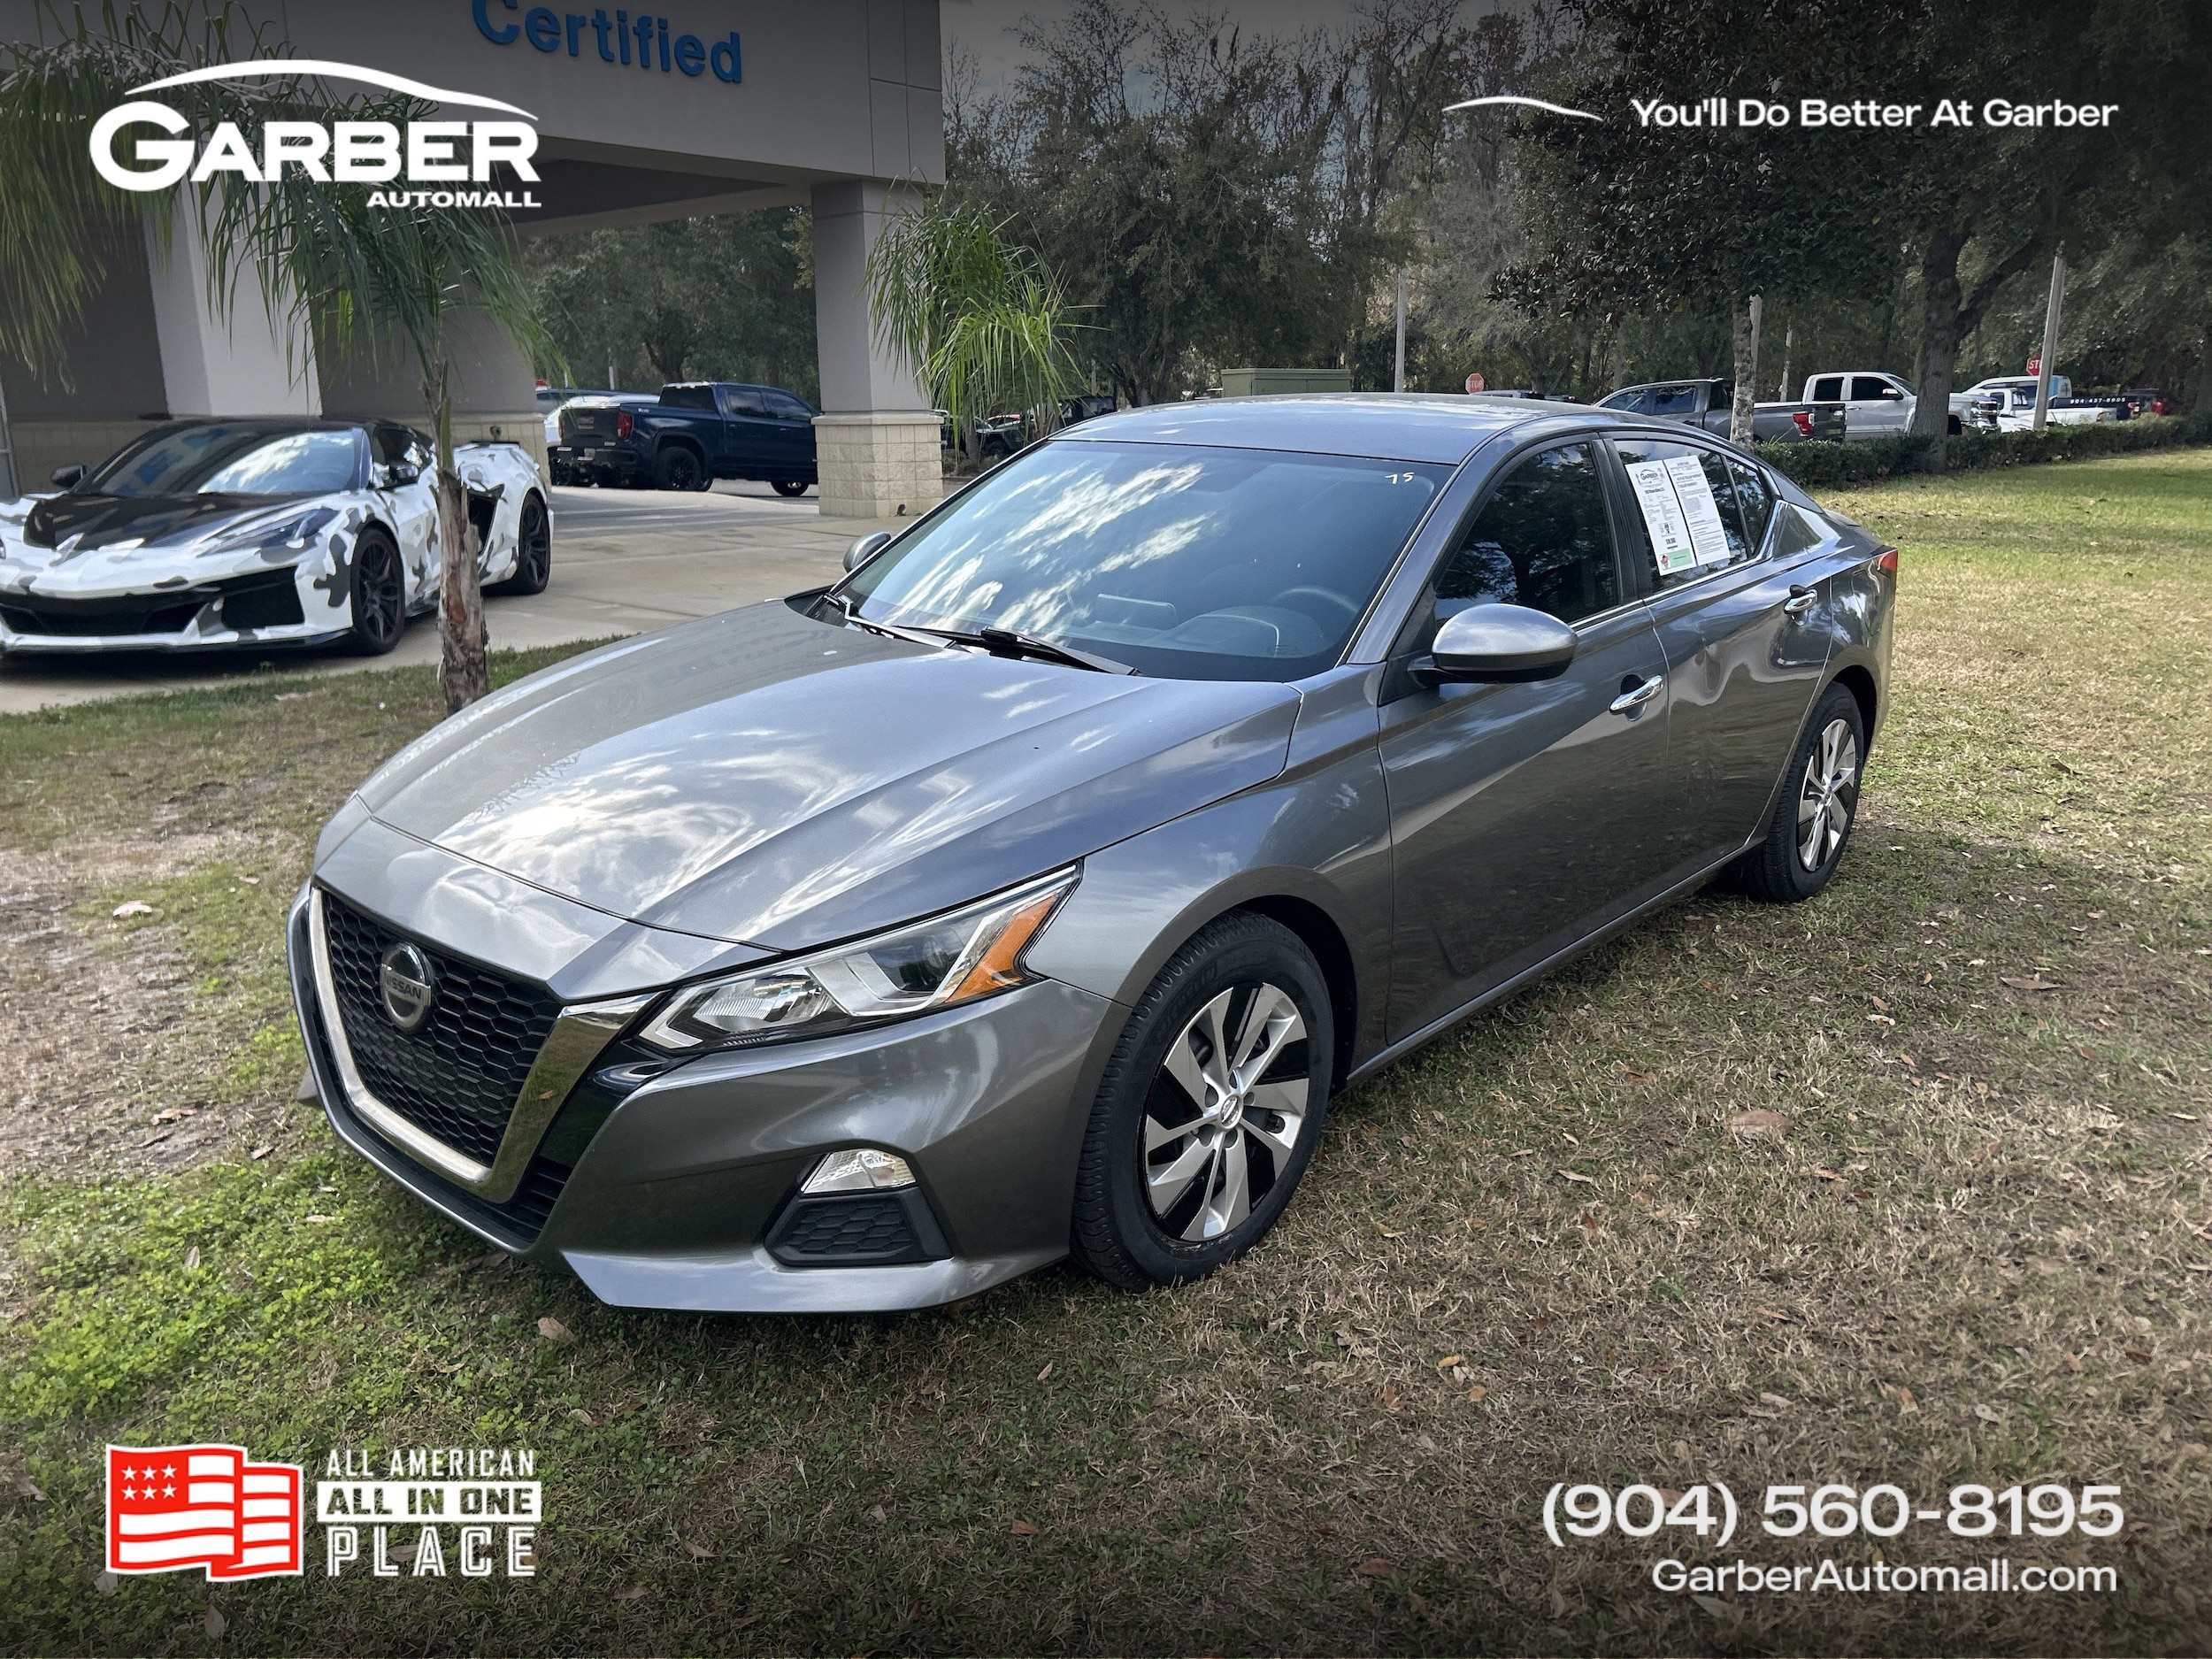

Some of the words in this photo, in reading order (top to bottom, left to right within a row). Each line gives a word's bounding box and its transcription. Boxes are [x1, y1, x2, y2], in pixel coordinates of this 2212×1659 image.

[472, 0, 741, 83] Certified
[2028, 359, 2041, 370] ST
[1468, 380, 1483, 388] STOP
[386, 974, 422, 1000] NISSAN
